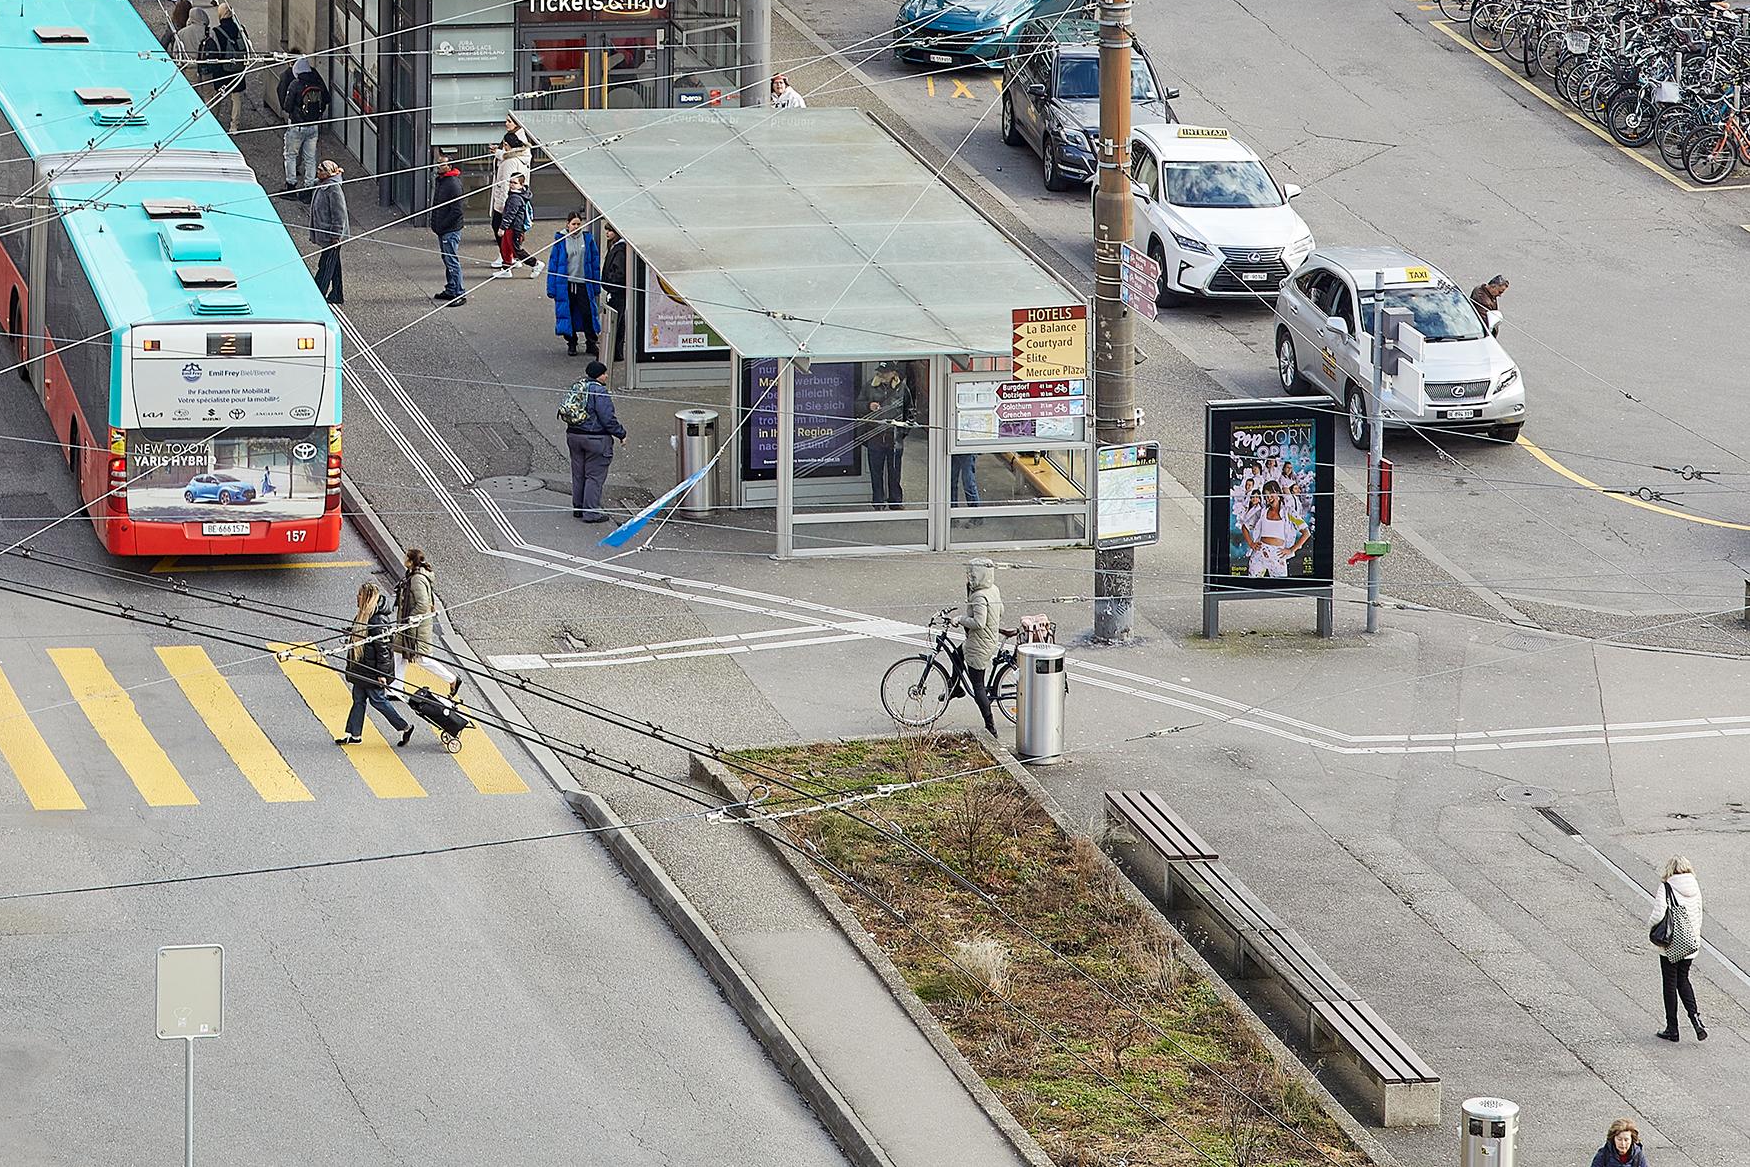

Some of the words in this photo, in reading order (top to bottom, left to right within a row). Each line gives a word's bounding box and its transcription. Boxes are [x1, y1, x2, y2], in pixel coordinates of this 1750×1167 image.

[1409, 270, 1428, 279] TAXI
[1028, 307, 1072, 321] HOTELS
[1026, 325, 1037, 334] La
[1040, 322, 1077, 333] Balance
[1026, 337, 1073, 349] Courtyard
[1026, 353, 1047, 363] Elite
[208, 369, 224, 377] Emil
[225, 369, 240, 378] Frey
[1026, 366, 1060, 377] Mercure
[1063, 365, 1085, 376] Plaza
[1002, 383, 1030, 392] Burgdorf
[196, 396, 231, 404] spécialiste
[819, 401, 845, 411] sich
[1002, 402, 1032, 411] Solothurn
[798, 428, 833, 439] Region
[134, 444, 163, 454] NEW
[166, 443, 212, 454] TOYOTA
[1257, 444, 1311, 459] OPERA
[134, 456, 169, 466] YARIS
[171, 455, 217, 466] HYBRID
[285, 530, 307, 542] 157
